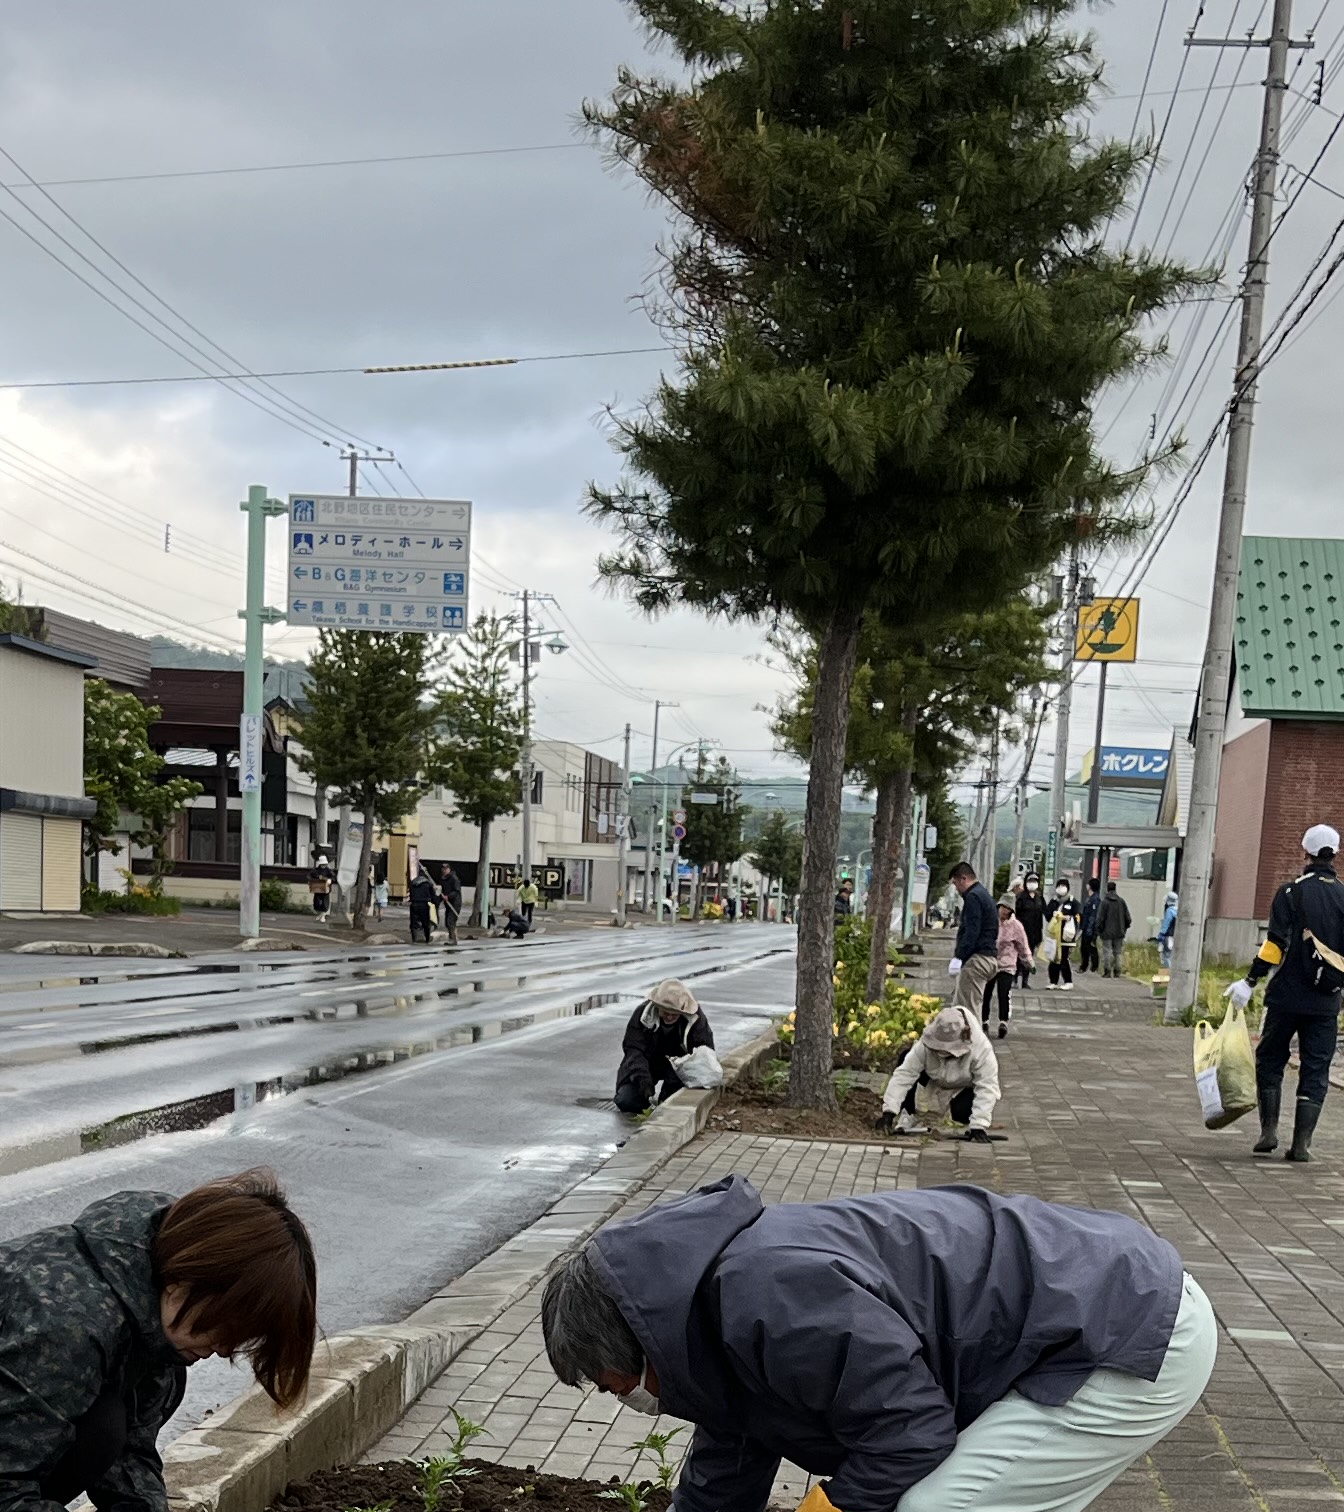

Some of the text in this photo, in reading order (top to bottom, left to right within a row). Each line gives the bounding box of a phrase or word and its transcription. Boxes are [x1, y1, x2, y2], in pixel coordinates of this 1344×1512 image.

[321, 501, 447, 518] 北野地区住民センター
[318, 534, 444, 549] メロディーホール
[352, 549, 404, 558] Melody Hall
[365, 584, 408, 593] Gymnasium
[311, 600, 438, 618] 鷹栖養護学校
[339, 616, 362, 624] School
[365, 617, 375, 625] for
[378, 617, 390, 625] the
[392, 618, 438, 628] Handicapped
[1102, 753, 1168, 773] ホクレン
[546, 871, 559, 885] P
